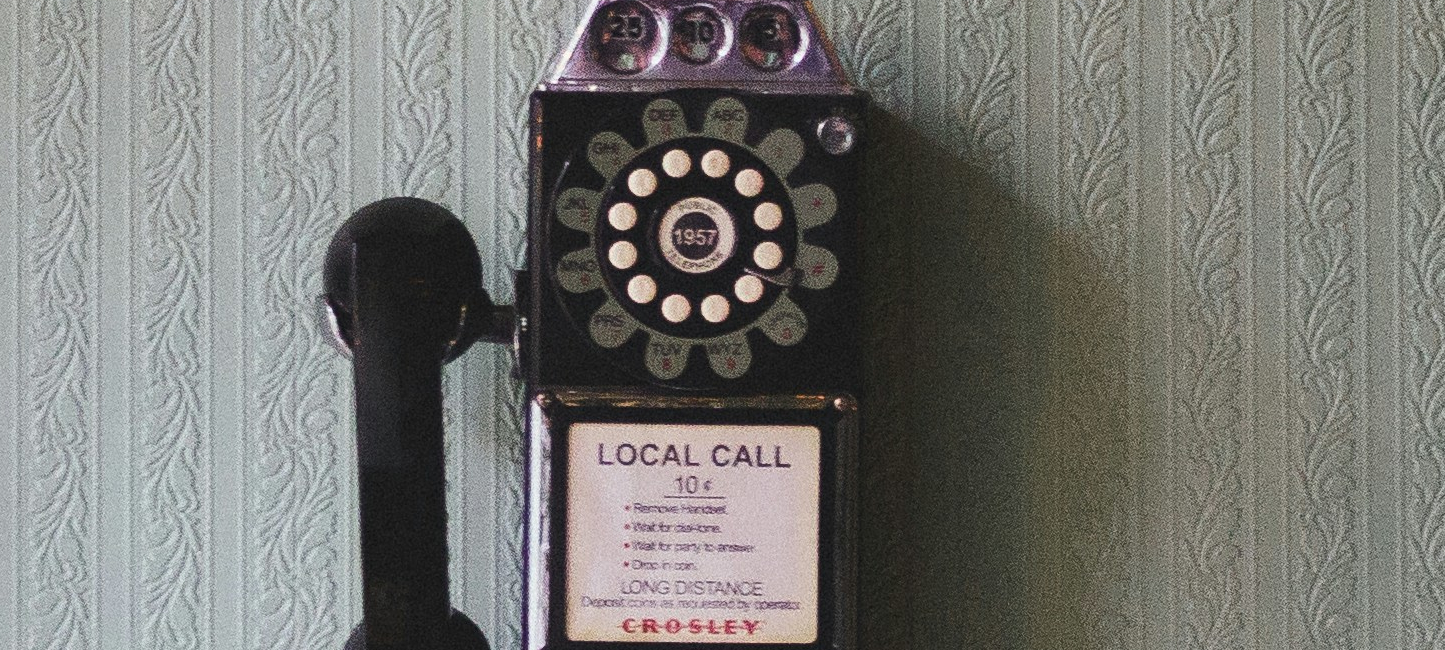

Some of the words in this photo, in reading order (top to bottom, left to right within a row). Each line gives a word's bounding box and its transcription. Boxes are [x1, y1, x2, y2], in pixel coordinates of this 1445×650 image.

[610, 16, 643, 39] 25
[687, 20, 715, 44] 10
[648, 110, 677, 122] DEF
[713, 109, 743, 122] ABC
[678, 199, 717, 214] PUBLIC
[674, 228, 717, 246] 1957
[667, 249, 723, 269] TELEPHONE
[653, 343, 682, 356] TUV
[598, 443, 700, 466] LOCAL
[711, 444, 791, 468] CALL
[675, 475, 698, 494] 10
[633, 502, 678, 514] Remove
[632, 522, 656, 533] Wait
[658, 521, 672, 533] for
[632, 541, 656, 551] Wait
[658, 541, 671, 552] for
[674, 543, 700, 554] party
[704, 542, 715, 552] to
[631, 559, 659, 570] Drop
[662, 559, 671, 570] in
[622, 579, 670, 595] LONG
[675, 581, 763, 597] DISTANCE
[580, 596, 624, 609] Deposit
[627, 599, 656, 609] coins
[660, 599, 674, 609] as
[677, 599, 734, 611] requested
[737, 598, 750, 612] by
[621, 618, 760, 635] CROSLEY
